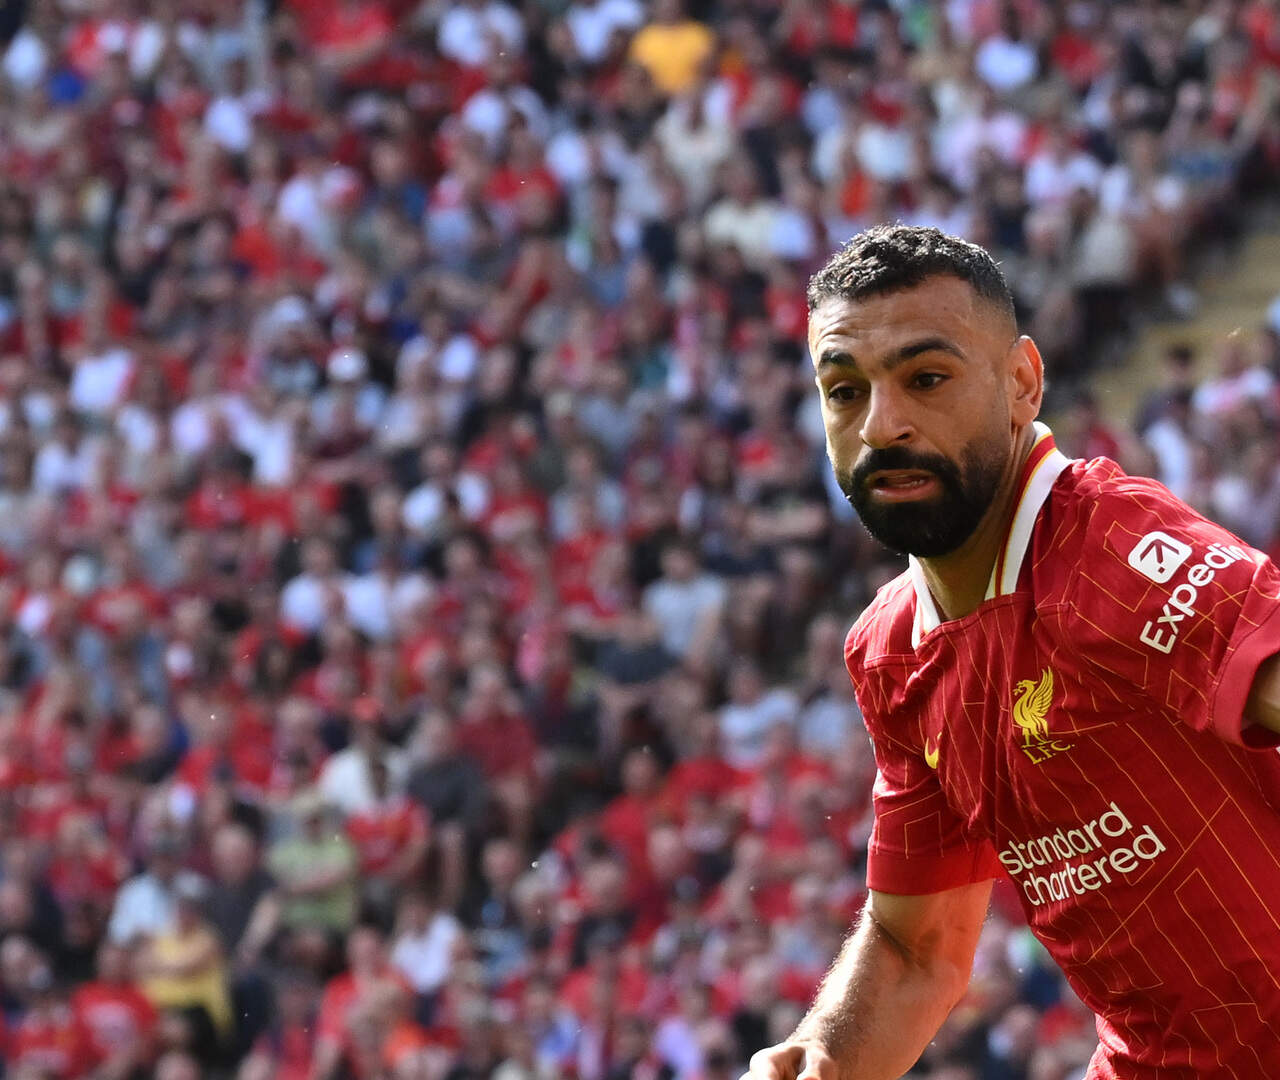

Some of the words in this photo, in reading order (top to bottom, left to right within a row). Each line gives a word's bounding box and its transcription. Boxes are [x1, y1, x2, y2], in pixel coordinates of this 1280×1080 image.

[1020, 739, 1075, 765] L.F.C.
[998, 801, 1133, 875] standard
[1023, 825, 1167, 906] chartered
